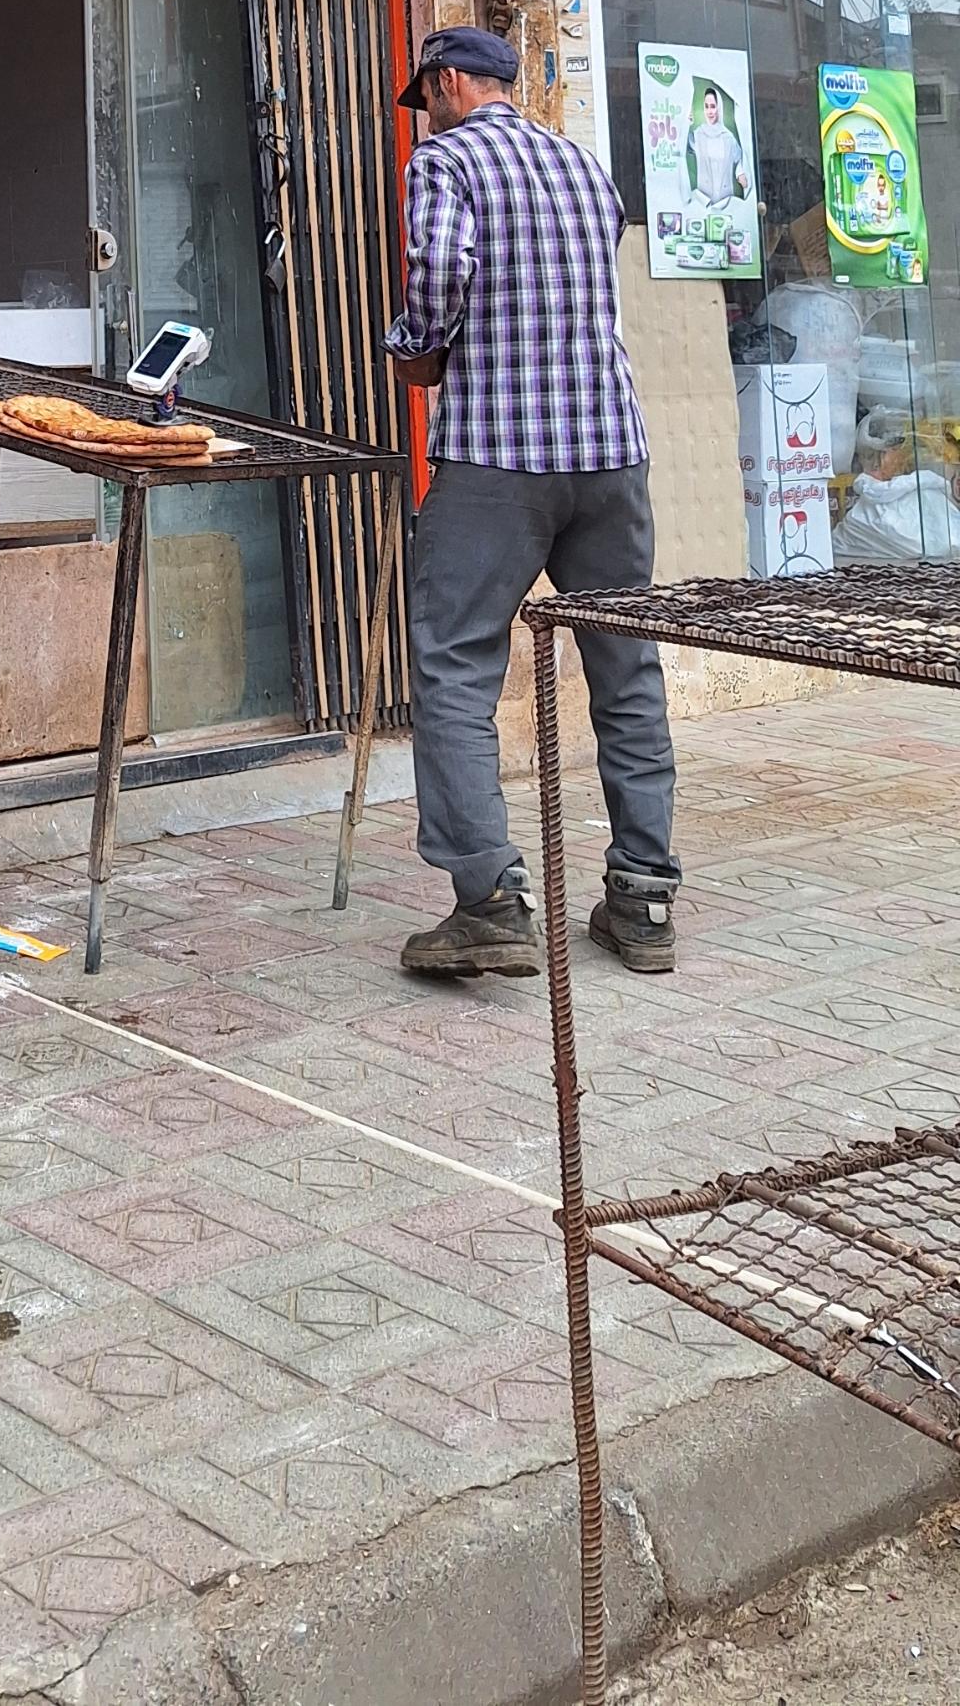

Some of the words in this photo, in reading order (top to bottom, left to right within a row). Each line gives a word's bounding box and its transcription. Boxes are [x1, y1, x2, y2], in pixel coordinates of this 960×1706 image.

[647, 58, 678, 77] molped
[826, 73, 866, 91] molfix
[847, 158, 874, 171] molfix
